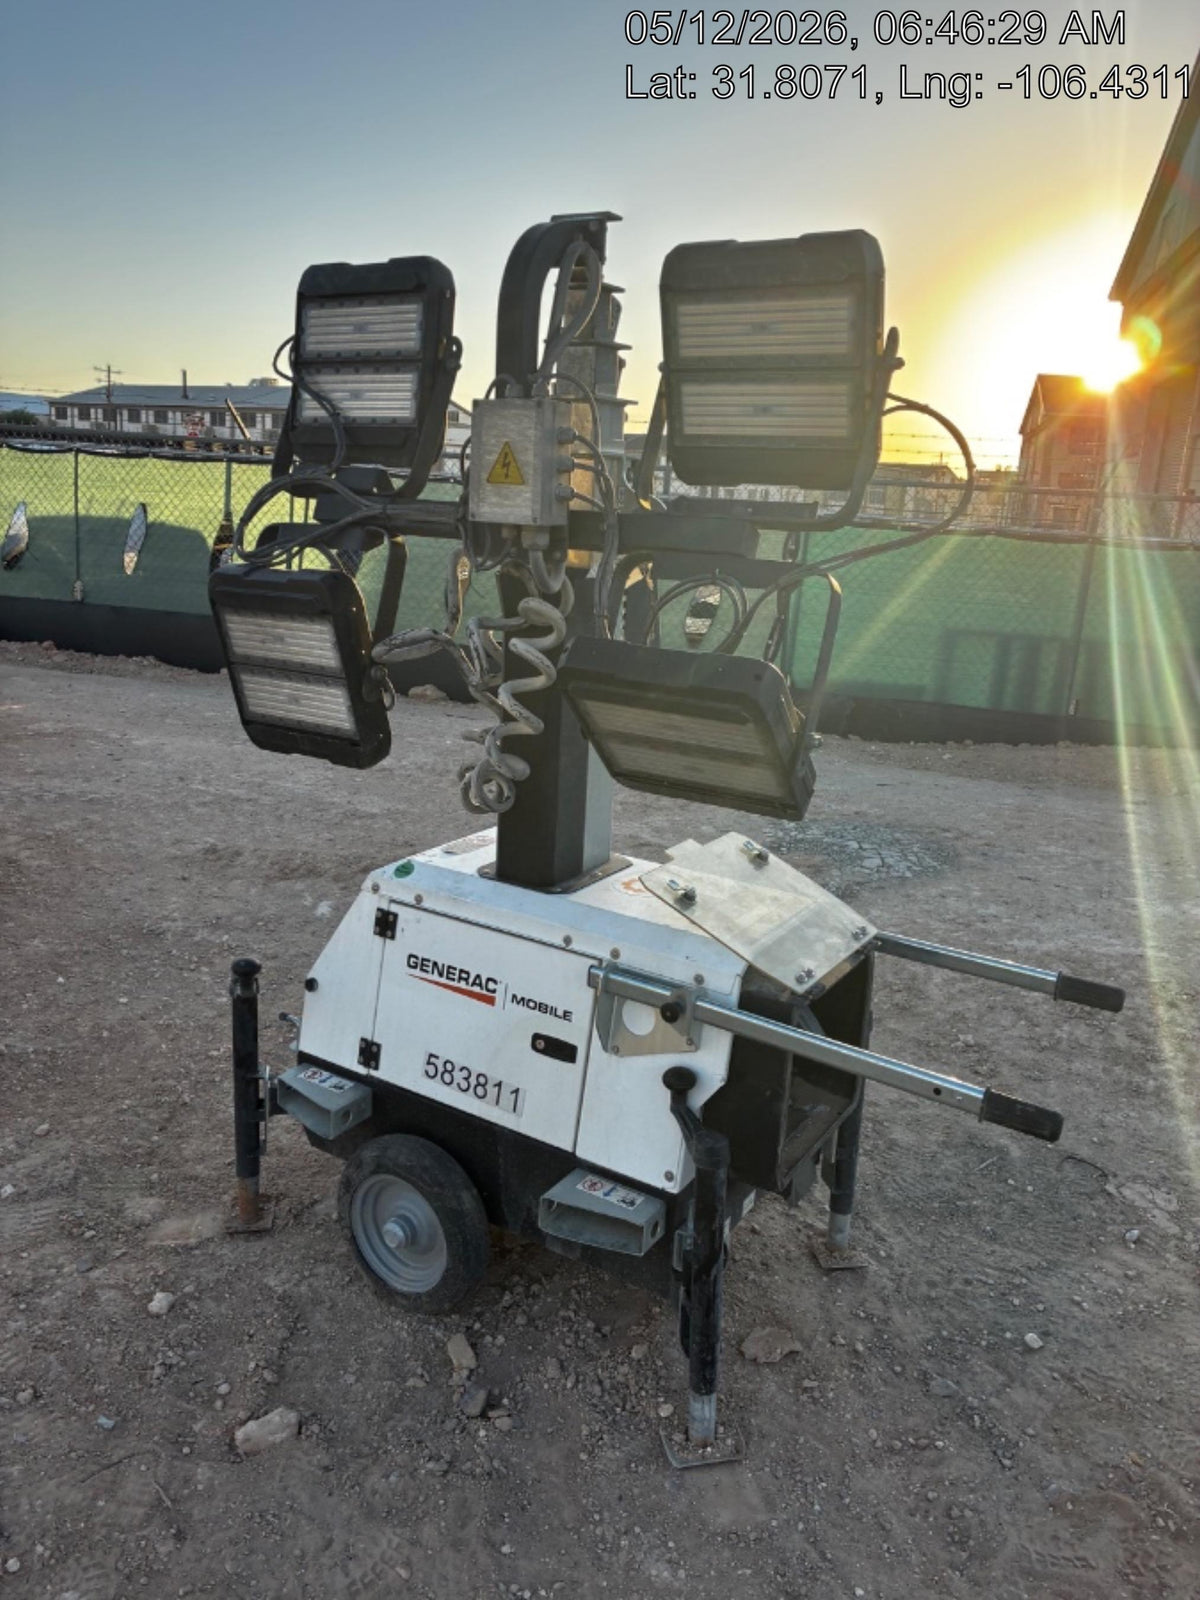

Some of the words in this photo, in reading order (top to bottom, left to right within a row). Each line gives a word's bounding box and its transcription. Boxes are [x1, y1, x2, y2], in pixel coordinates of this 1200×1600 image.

[406, 953, 499, 995] GENERAC
[511, 993, 573, 1022] MOBILE
[424, 1053, 521, 1114] 583811
